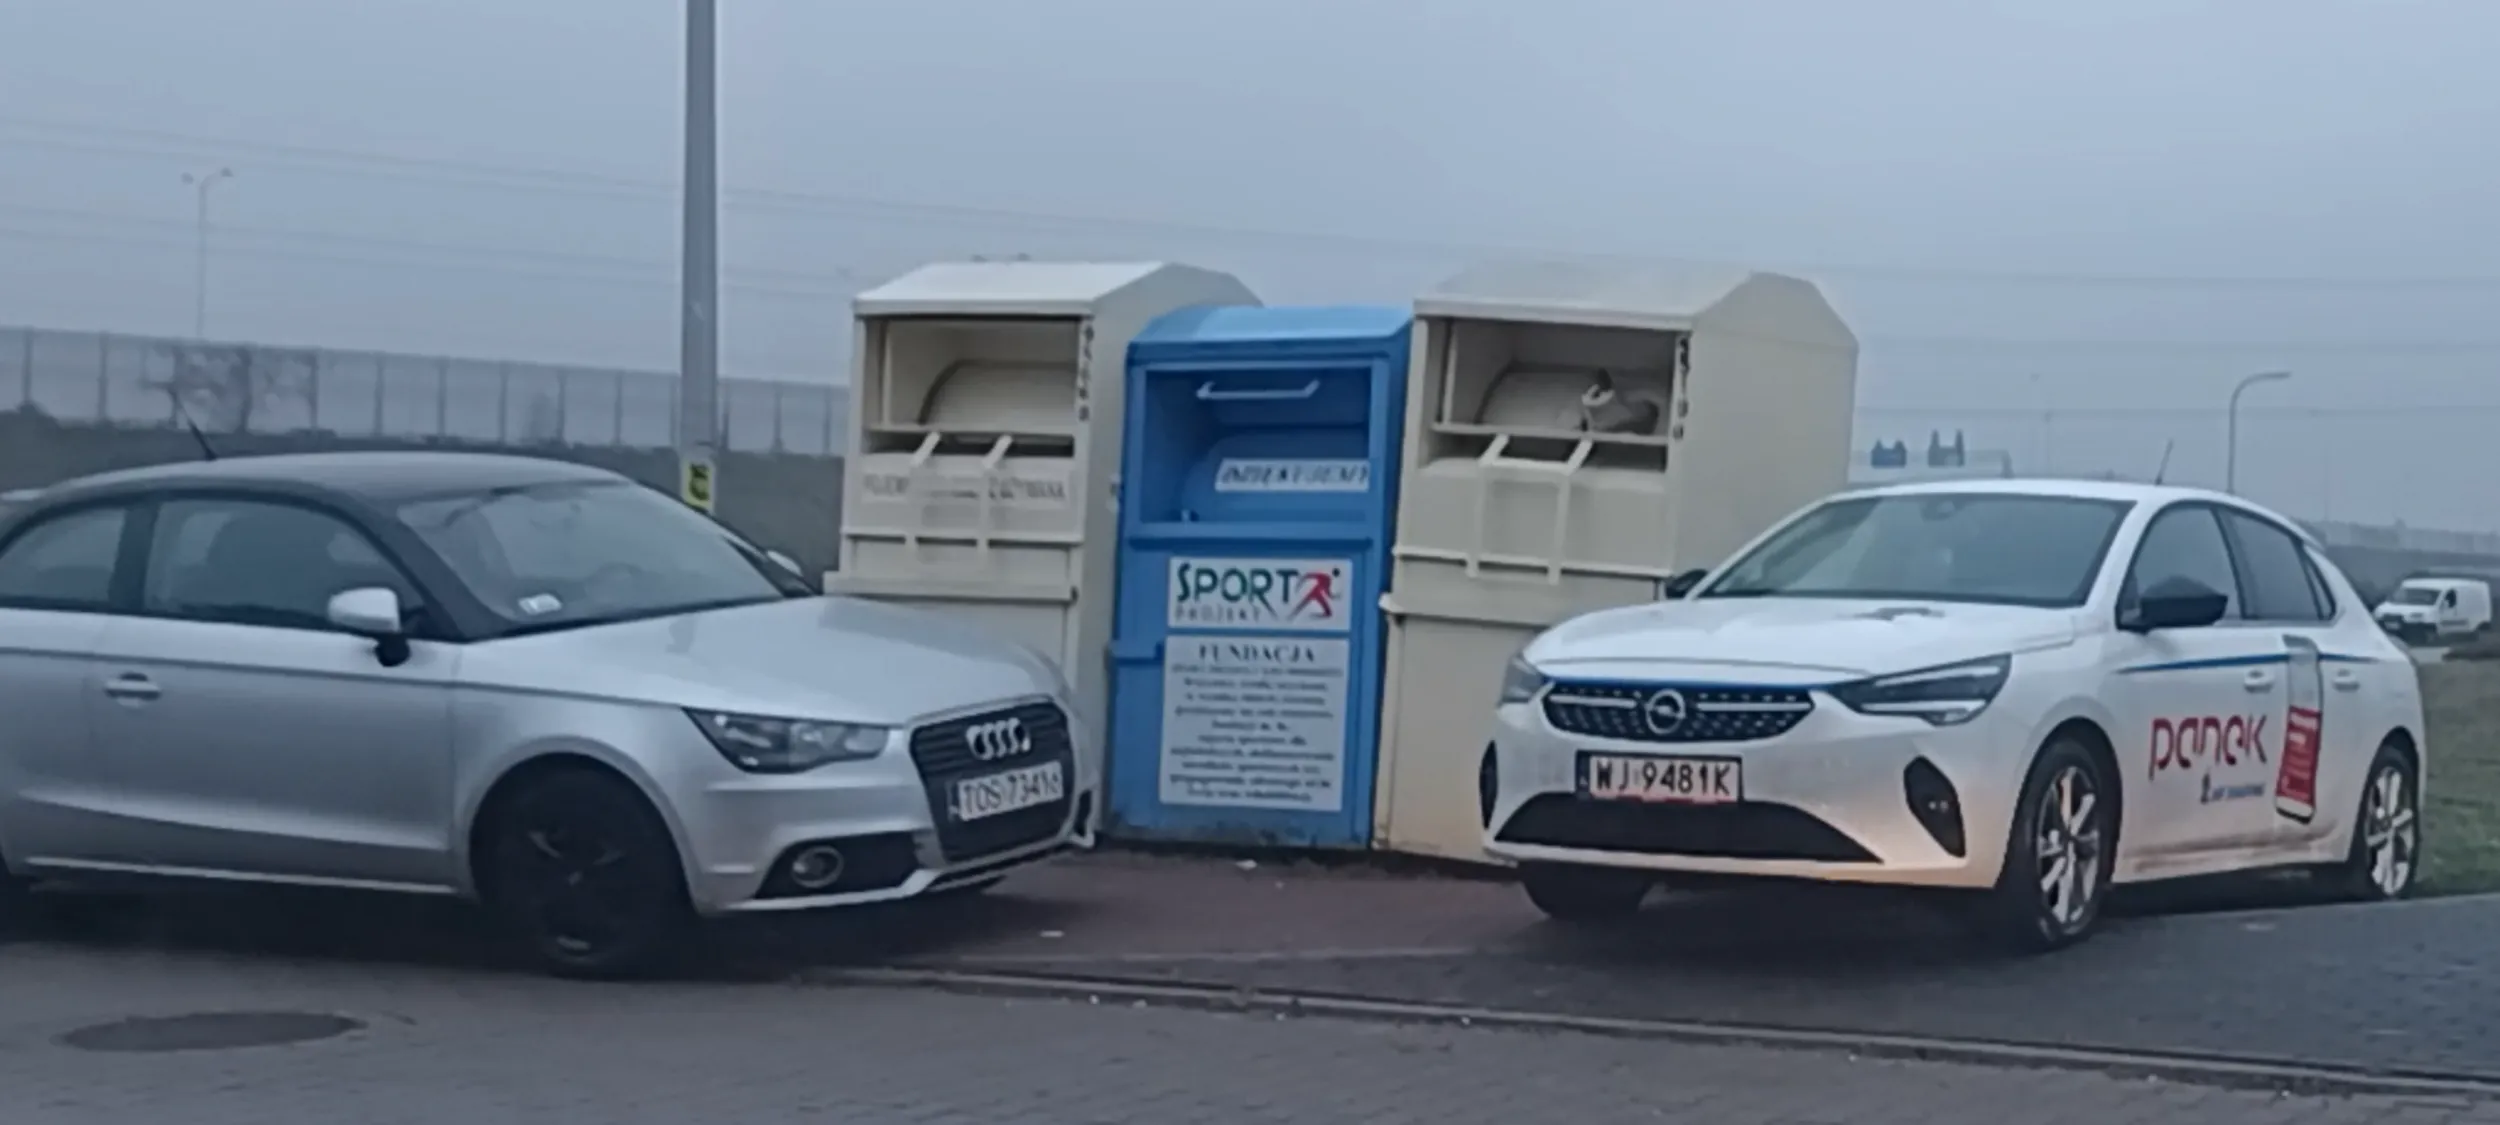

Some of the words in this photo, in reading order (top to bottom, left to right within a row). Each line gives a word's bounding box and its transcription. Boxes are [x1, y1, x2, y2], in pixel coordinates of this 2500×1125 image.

[1176, 562, 1299, 621] SPORT
[1199, 644, 1316, 663] FUNDACJA
[2148, 713, 2268, 782] panek
[1596, 759, 1630, 791] WJ
[1642, 760, 1731, 796] 9481K
